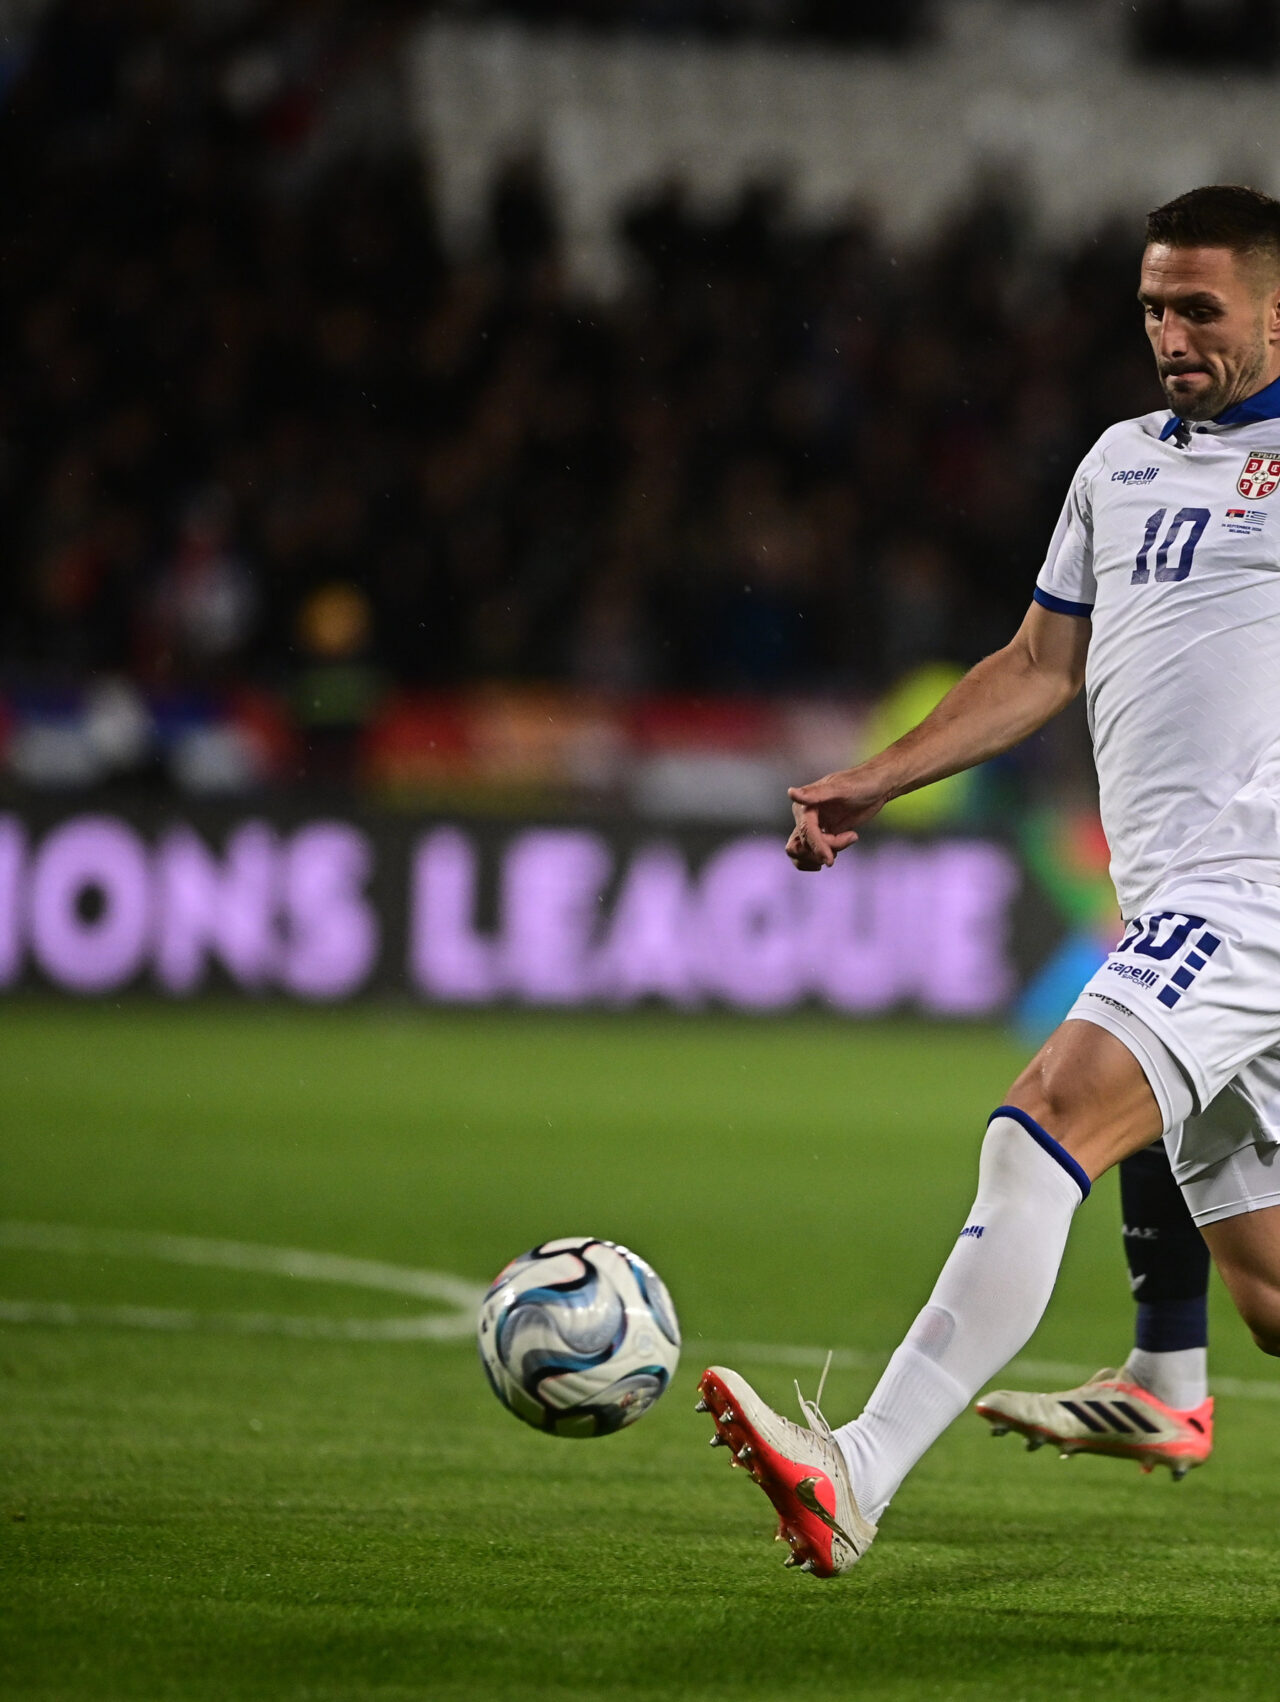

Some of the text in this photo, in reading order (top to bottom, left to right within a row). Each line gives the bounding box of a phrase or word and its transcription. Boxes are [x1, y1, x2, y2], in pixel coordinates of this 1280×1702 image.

[1111, 467, 1160, 483] capelli
[1130, 507, 1211, 585] 10
[408, 822, 1014, 1016] LEAGUE
[1107, 961, 1160, 987] capelli
